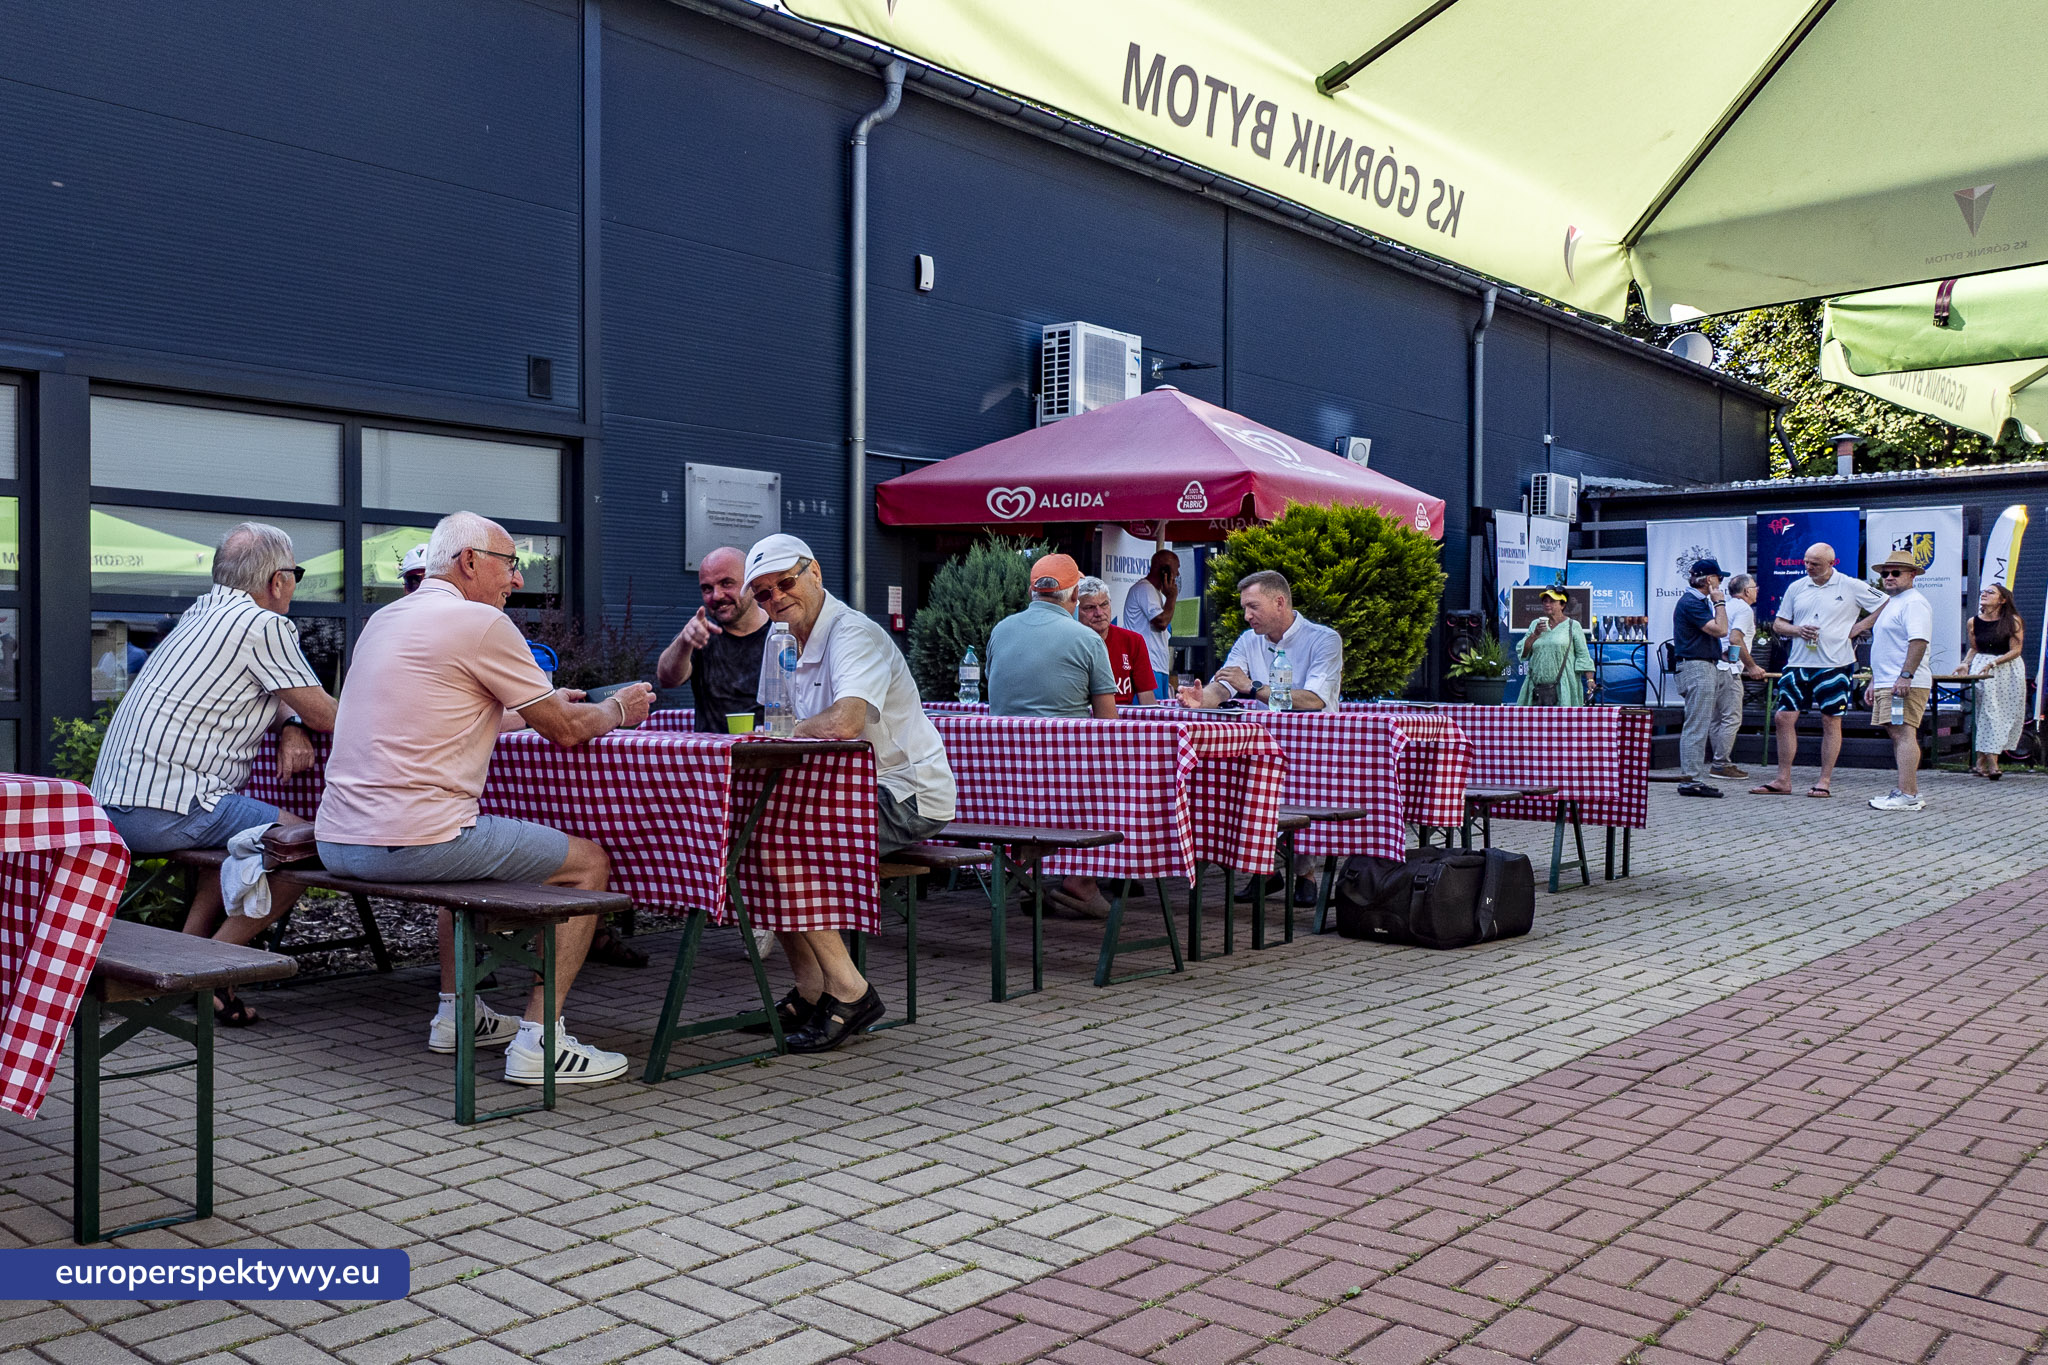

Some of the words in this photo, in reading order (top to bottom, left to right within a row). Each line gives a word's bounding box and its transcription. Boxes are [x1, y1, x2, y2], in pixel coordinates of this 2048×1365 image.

[1039, 492, 1105, 508] ALGIDA
[1618, 590, 1633, 601] 30
[1656, 587, 1685, 598] Busin
